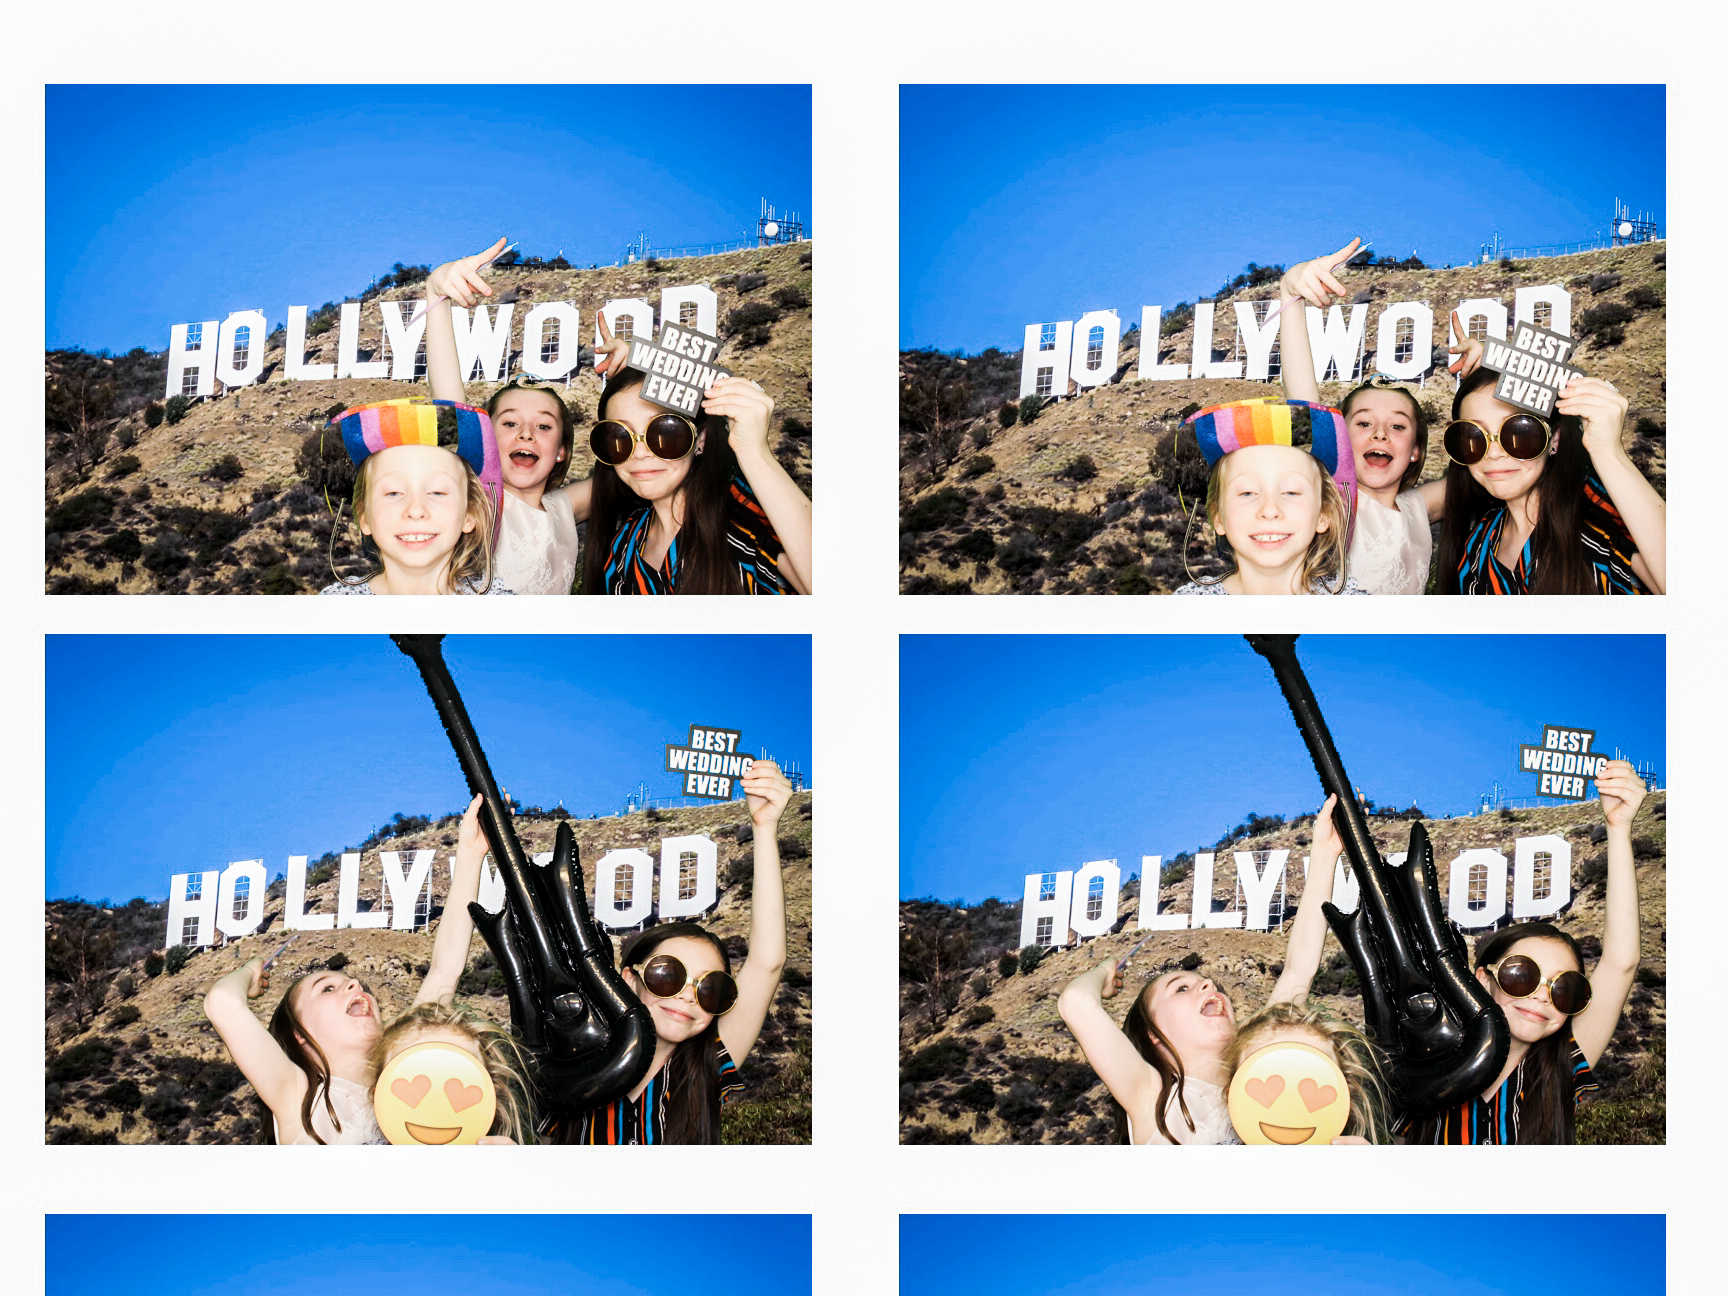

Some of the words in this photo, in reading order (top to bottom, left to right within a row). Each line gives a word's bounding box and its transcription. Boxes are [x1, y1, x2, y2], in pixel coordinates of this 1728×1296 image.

[661, 326, 718, 363] BEST
[1515, 326, 1572, 363] BEST
[631, 342, 730, 390] WEDDIN
[1485, 342, 1584, 390] WEDDIN
[645, 374, 699, 412] EVER
[1499, 374, 1553, 412] EVER
[692, 729, 738, 753] BEST
[1546, 729, 1592, 753] BEST
[669, 748, 754, 776] WEDDING
[1523, 748, 1608, 776] WEDDING
[687, 773, 731, 797] EVER
[1541, 773, 1585, 797] EVER
